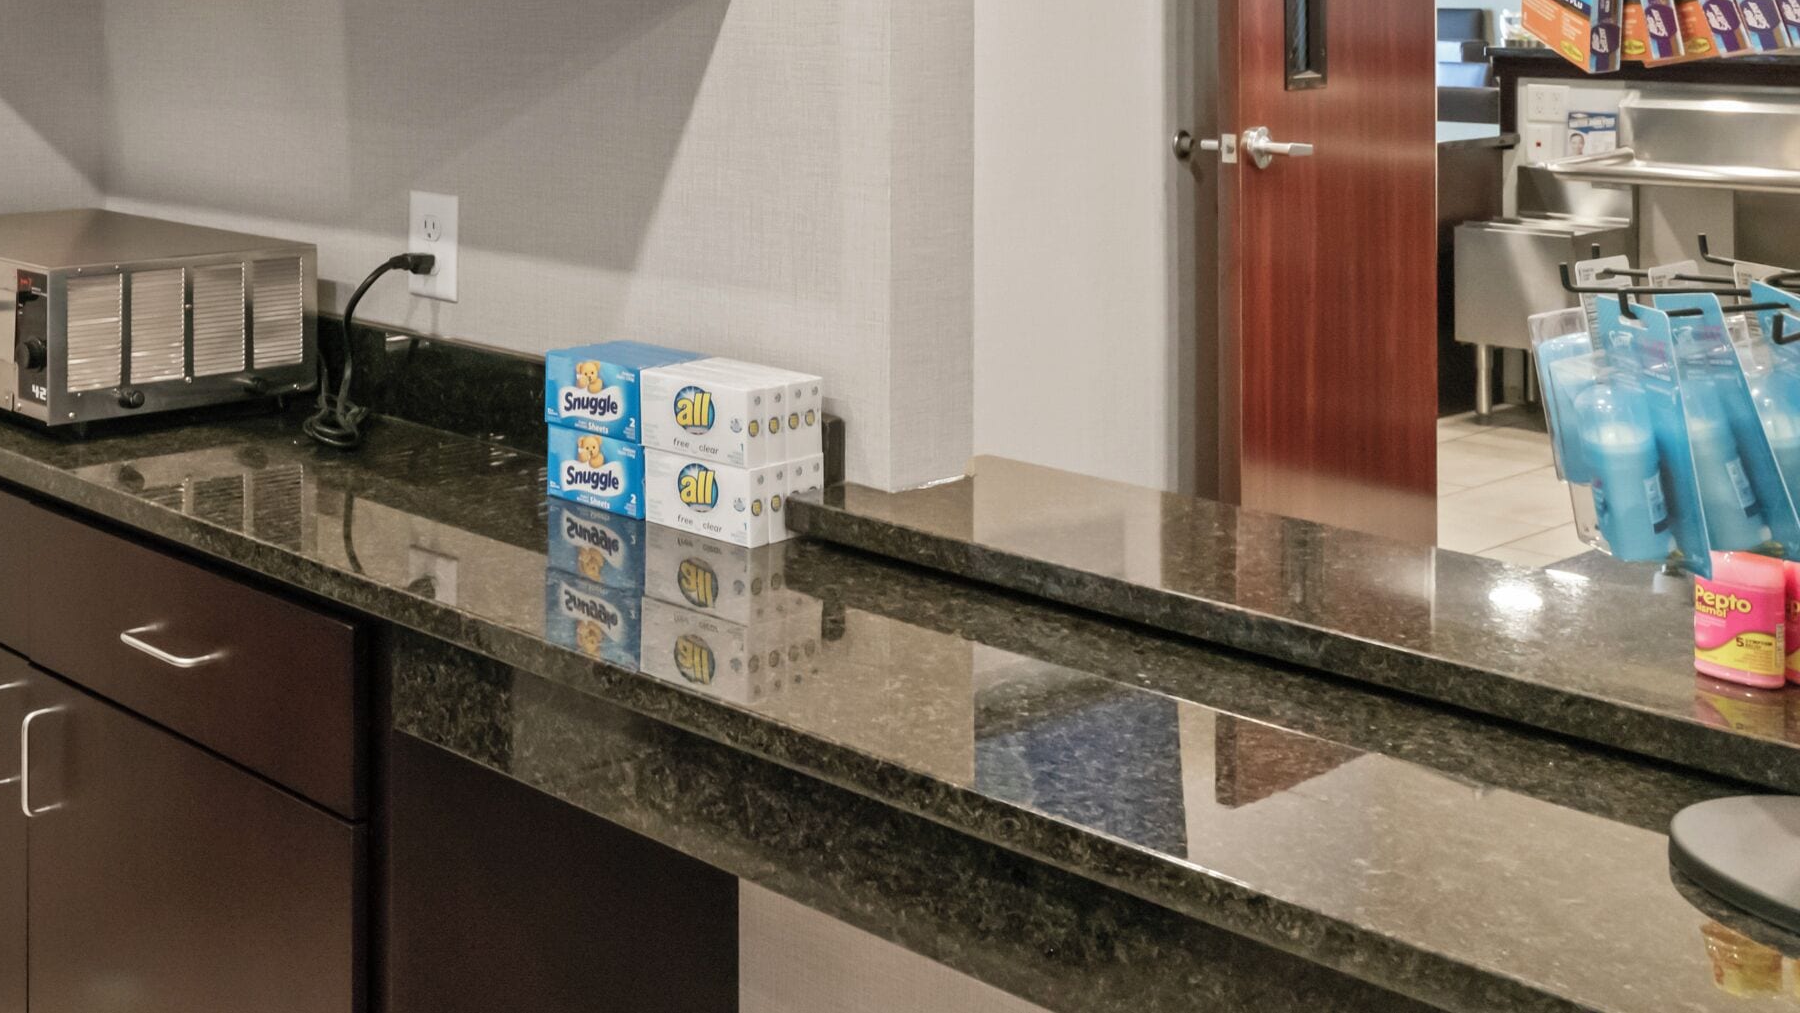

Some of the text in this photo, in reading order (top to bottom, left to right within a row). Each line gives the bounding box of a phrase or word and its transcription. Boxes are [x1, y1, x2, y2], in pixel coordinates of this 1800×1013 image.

[564, 392, 618, 416] Snuggle
[675, 392, 712, 428] all
[588, 422, 609, 435] Sheets
[629, 417, 636, 428] 2
[673, 437, 719, 456] free clear
[566, 465, 619, 491] Snuggle
[679, 470, 716, 505] all
[589, 496, 611, 510] Sheets
[630, 493, 637, 504] 2
[677, 514, 723, 533] free clear
[1696, 584, 1752, 613] Pepto
[1736, 636, 1745, 647] 5
